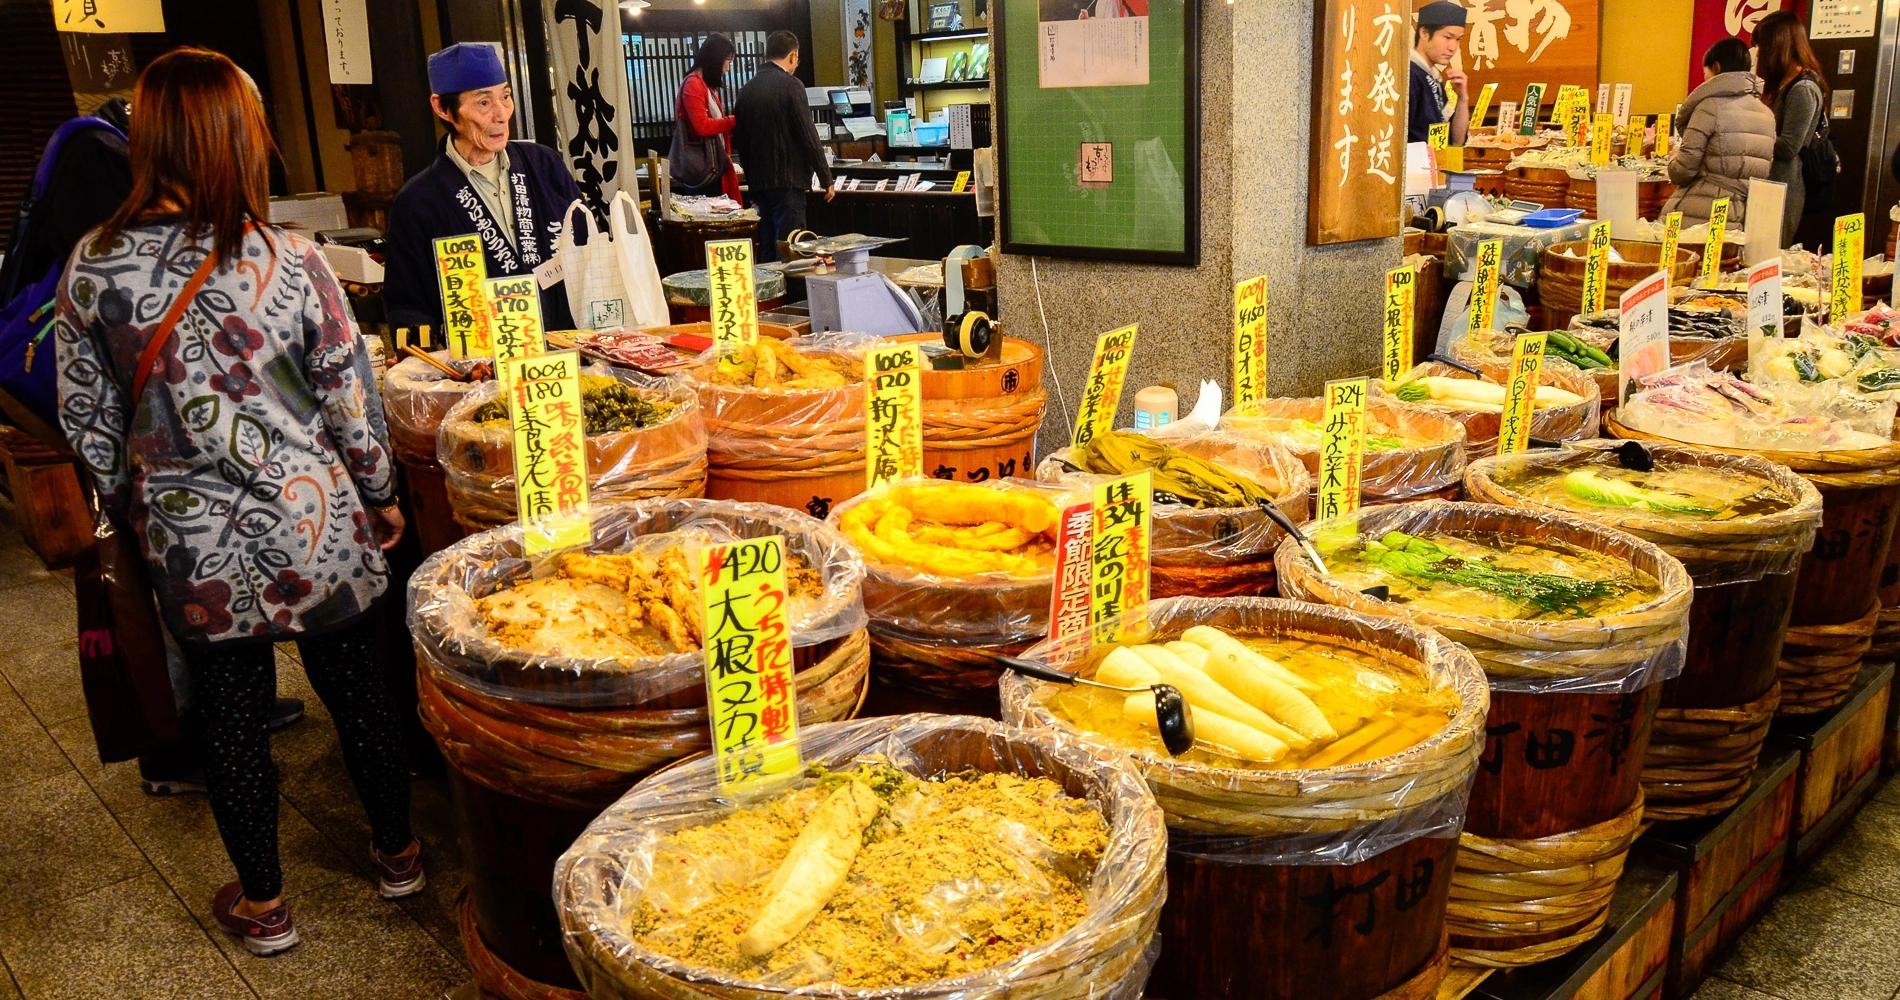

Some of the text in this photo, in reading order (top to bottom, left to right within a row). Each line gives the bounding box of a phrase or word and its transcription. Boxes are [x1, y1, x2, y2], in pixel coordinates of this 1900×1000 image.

[1334, 5, 1358, 188] ります
[1366, 3, 1402, 185] 方発送
[1522, 86, 1539, 128] 人気商品
[709, 245, 747, 267] ¥486
[1238, 277, 1267, 305] 100g
[1388, 272, 1411, 293] ¥420
[1239, 304, 1265, 328] ¥150
[1523, 339, 1541, 356] 100g
[520, 361, 567, 382] 100g
[514, 381, 563, 409] ¥180
[1331, 384, 1364, 410] ¥324
[1096, 500, 1145, 534] ¥324
[704, 540, 781, 586] ¥420
[1302, 857, 1434, 950] 打田
